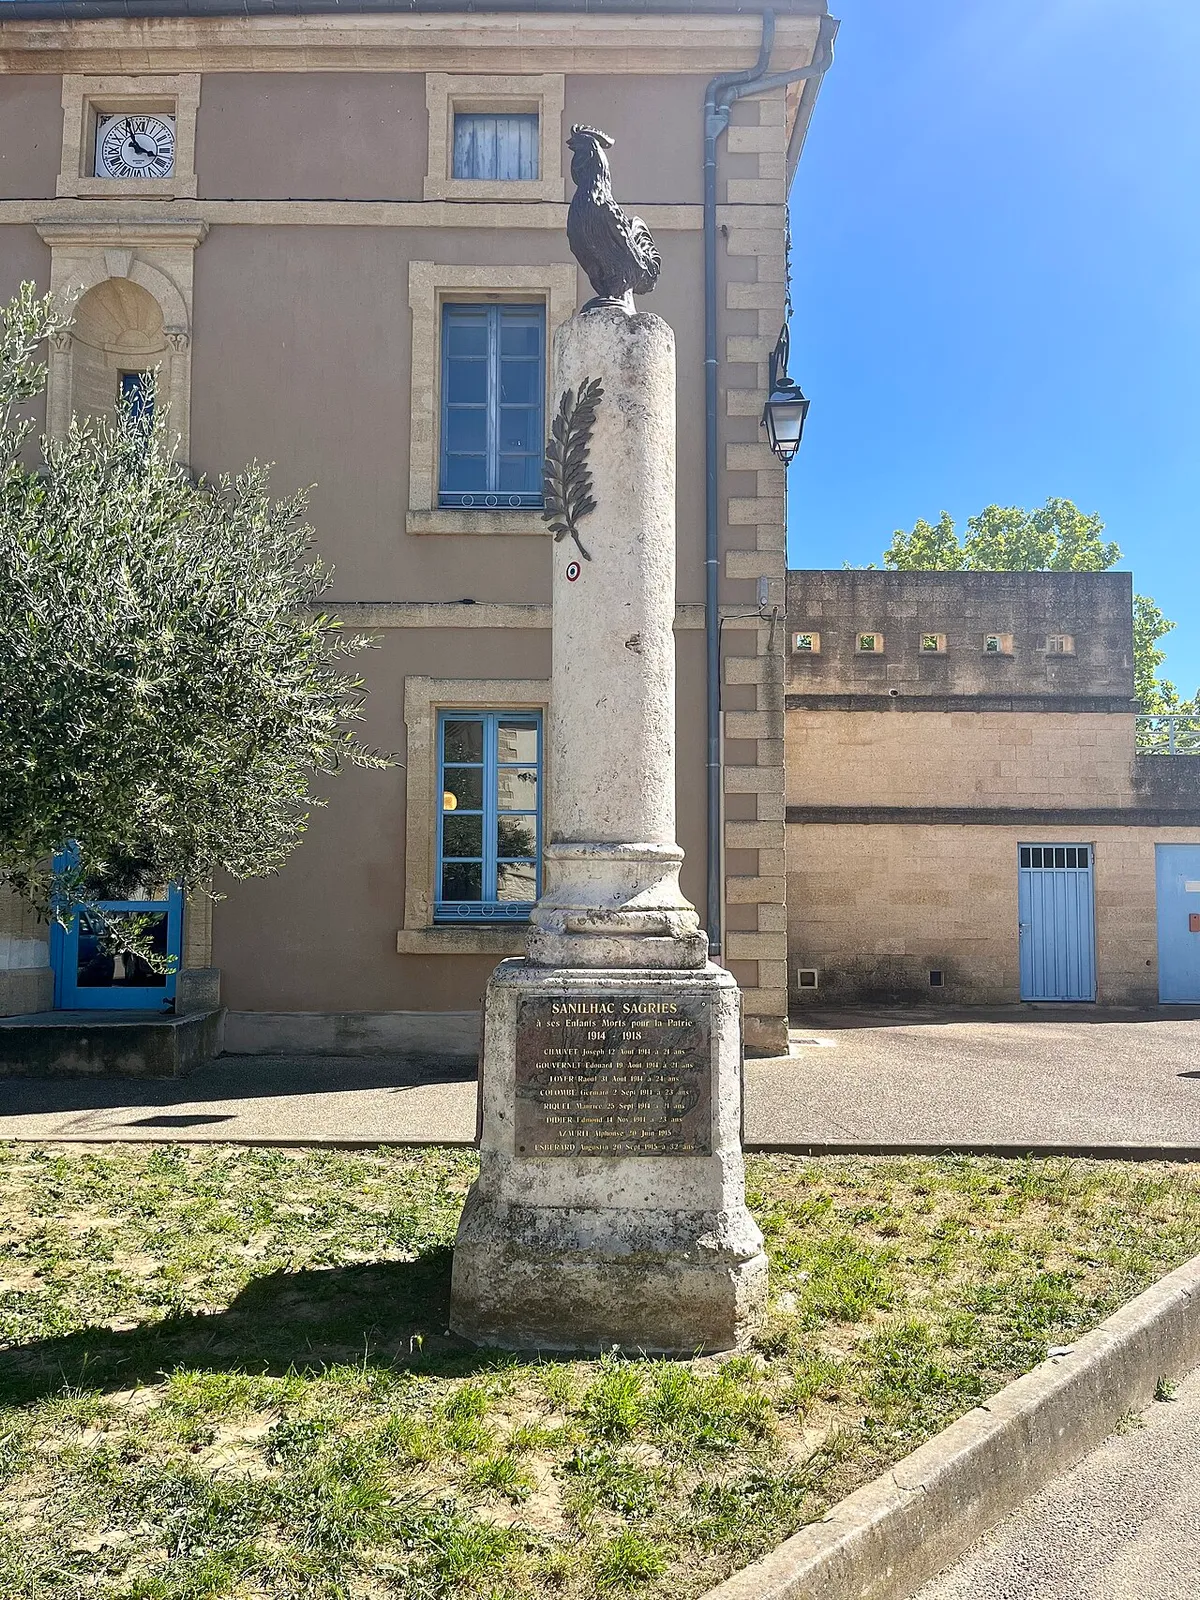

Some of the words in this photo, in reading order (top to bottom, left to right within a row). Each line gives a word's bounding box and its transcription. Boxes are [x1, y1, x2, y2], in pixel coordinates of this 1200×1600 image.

[551, 1002, 615, 1014] SANILHAC
[622, 1002, 678, 1014] SAGRIES
[565, 1019, 597, 1027] Enfants
[601, 1019, 626, 1027] Morts
[631, 1020, 651, 1029] pour
[667, 1018, 693, 1027] Patrie
[587, 1031, 606, 1040] 1914
[622, 1031, 642, 1040] 1918
[582, 1048, 605, 1057] Joseph
[640, 1129, 655, 1138] Juin
